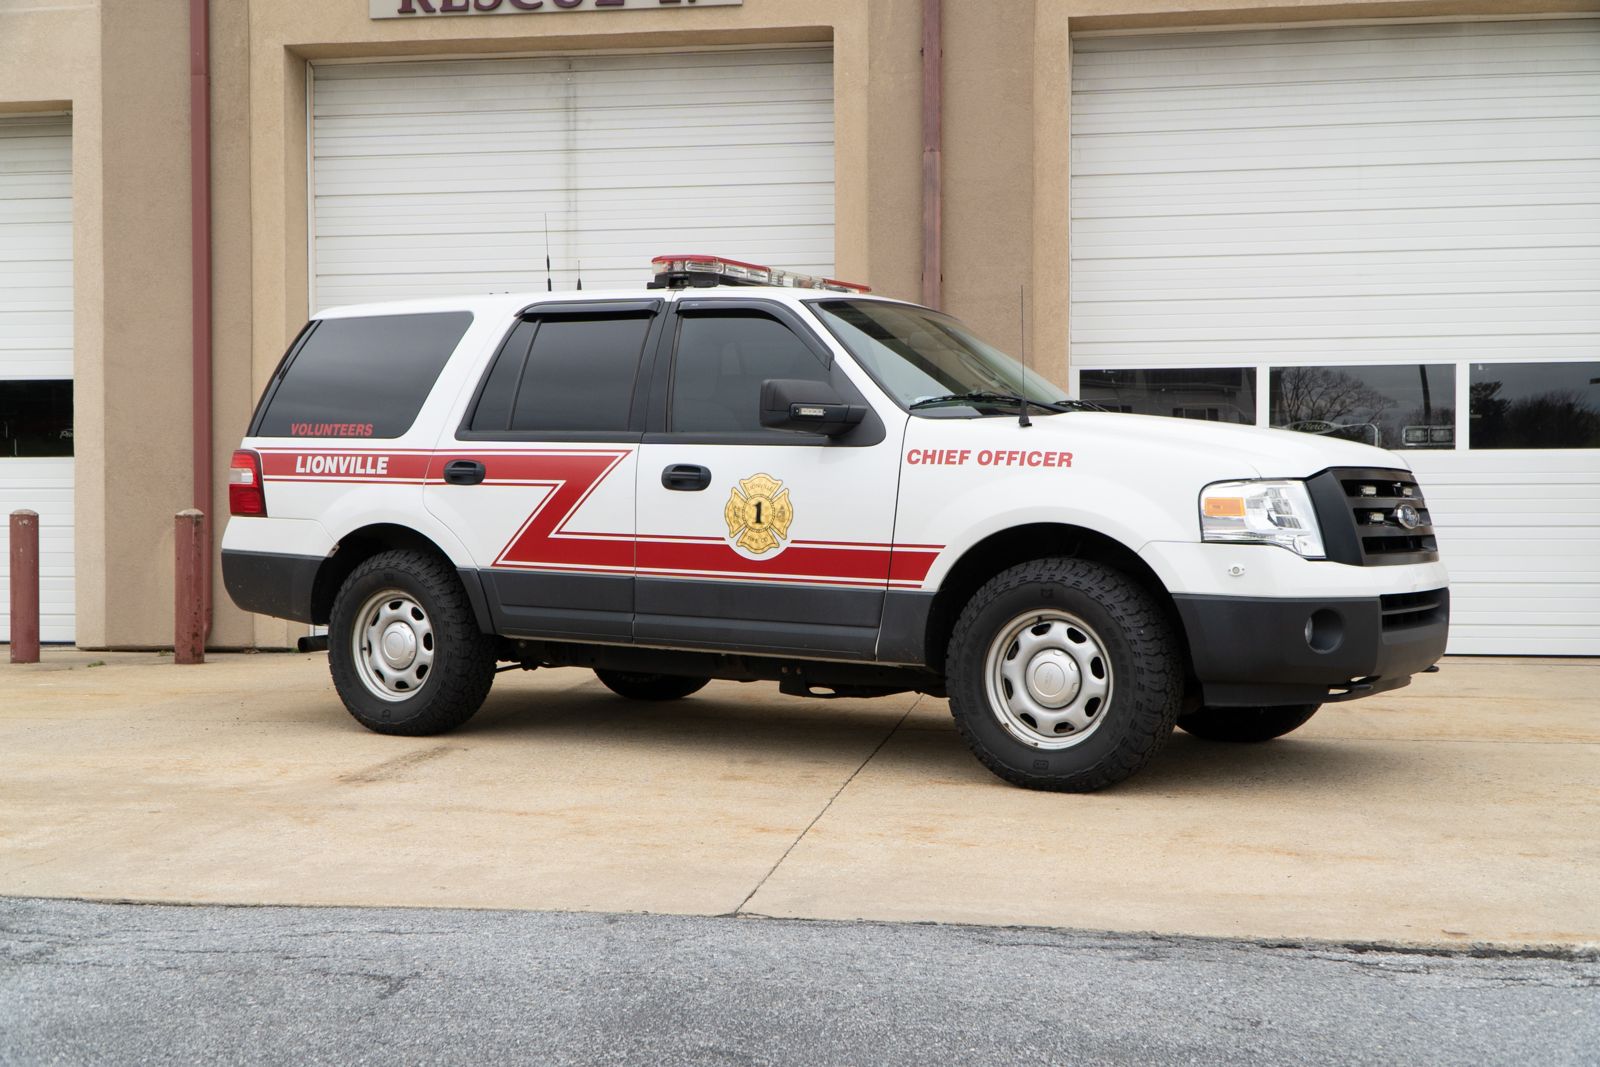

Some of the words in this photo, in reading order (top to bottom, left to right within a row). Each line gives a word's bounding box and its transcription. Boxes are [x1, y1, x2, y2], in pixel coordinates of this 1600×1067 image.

[290, 423, 373, 436] VOLUNTEERS
[295, 456, 389, 475] LIONVILLE
[906, 449, 971, 465] CHIEF
[977, 450, 1073, 467] OFFICER
[754, 501, 764, 524] 1
